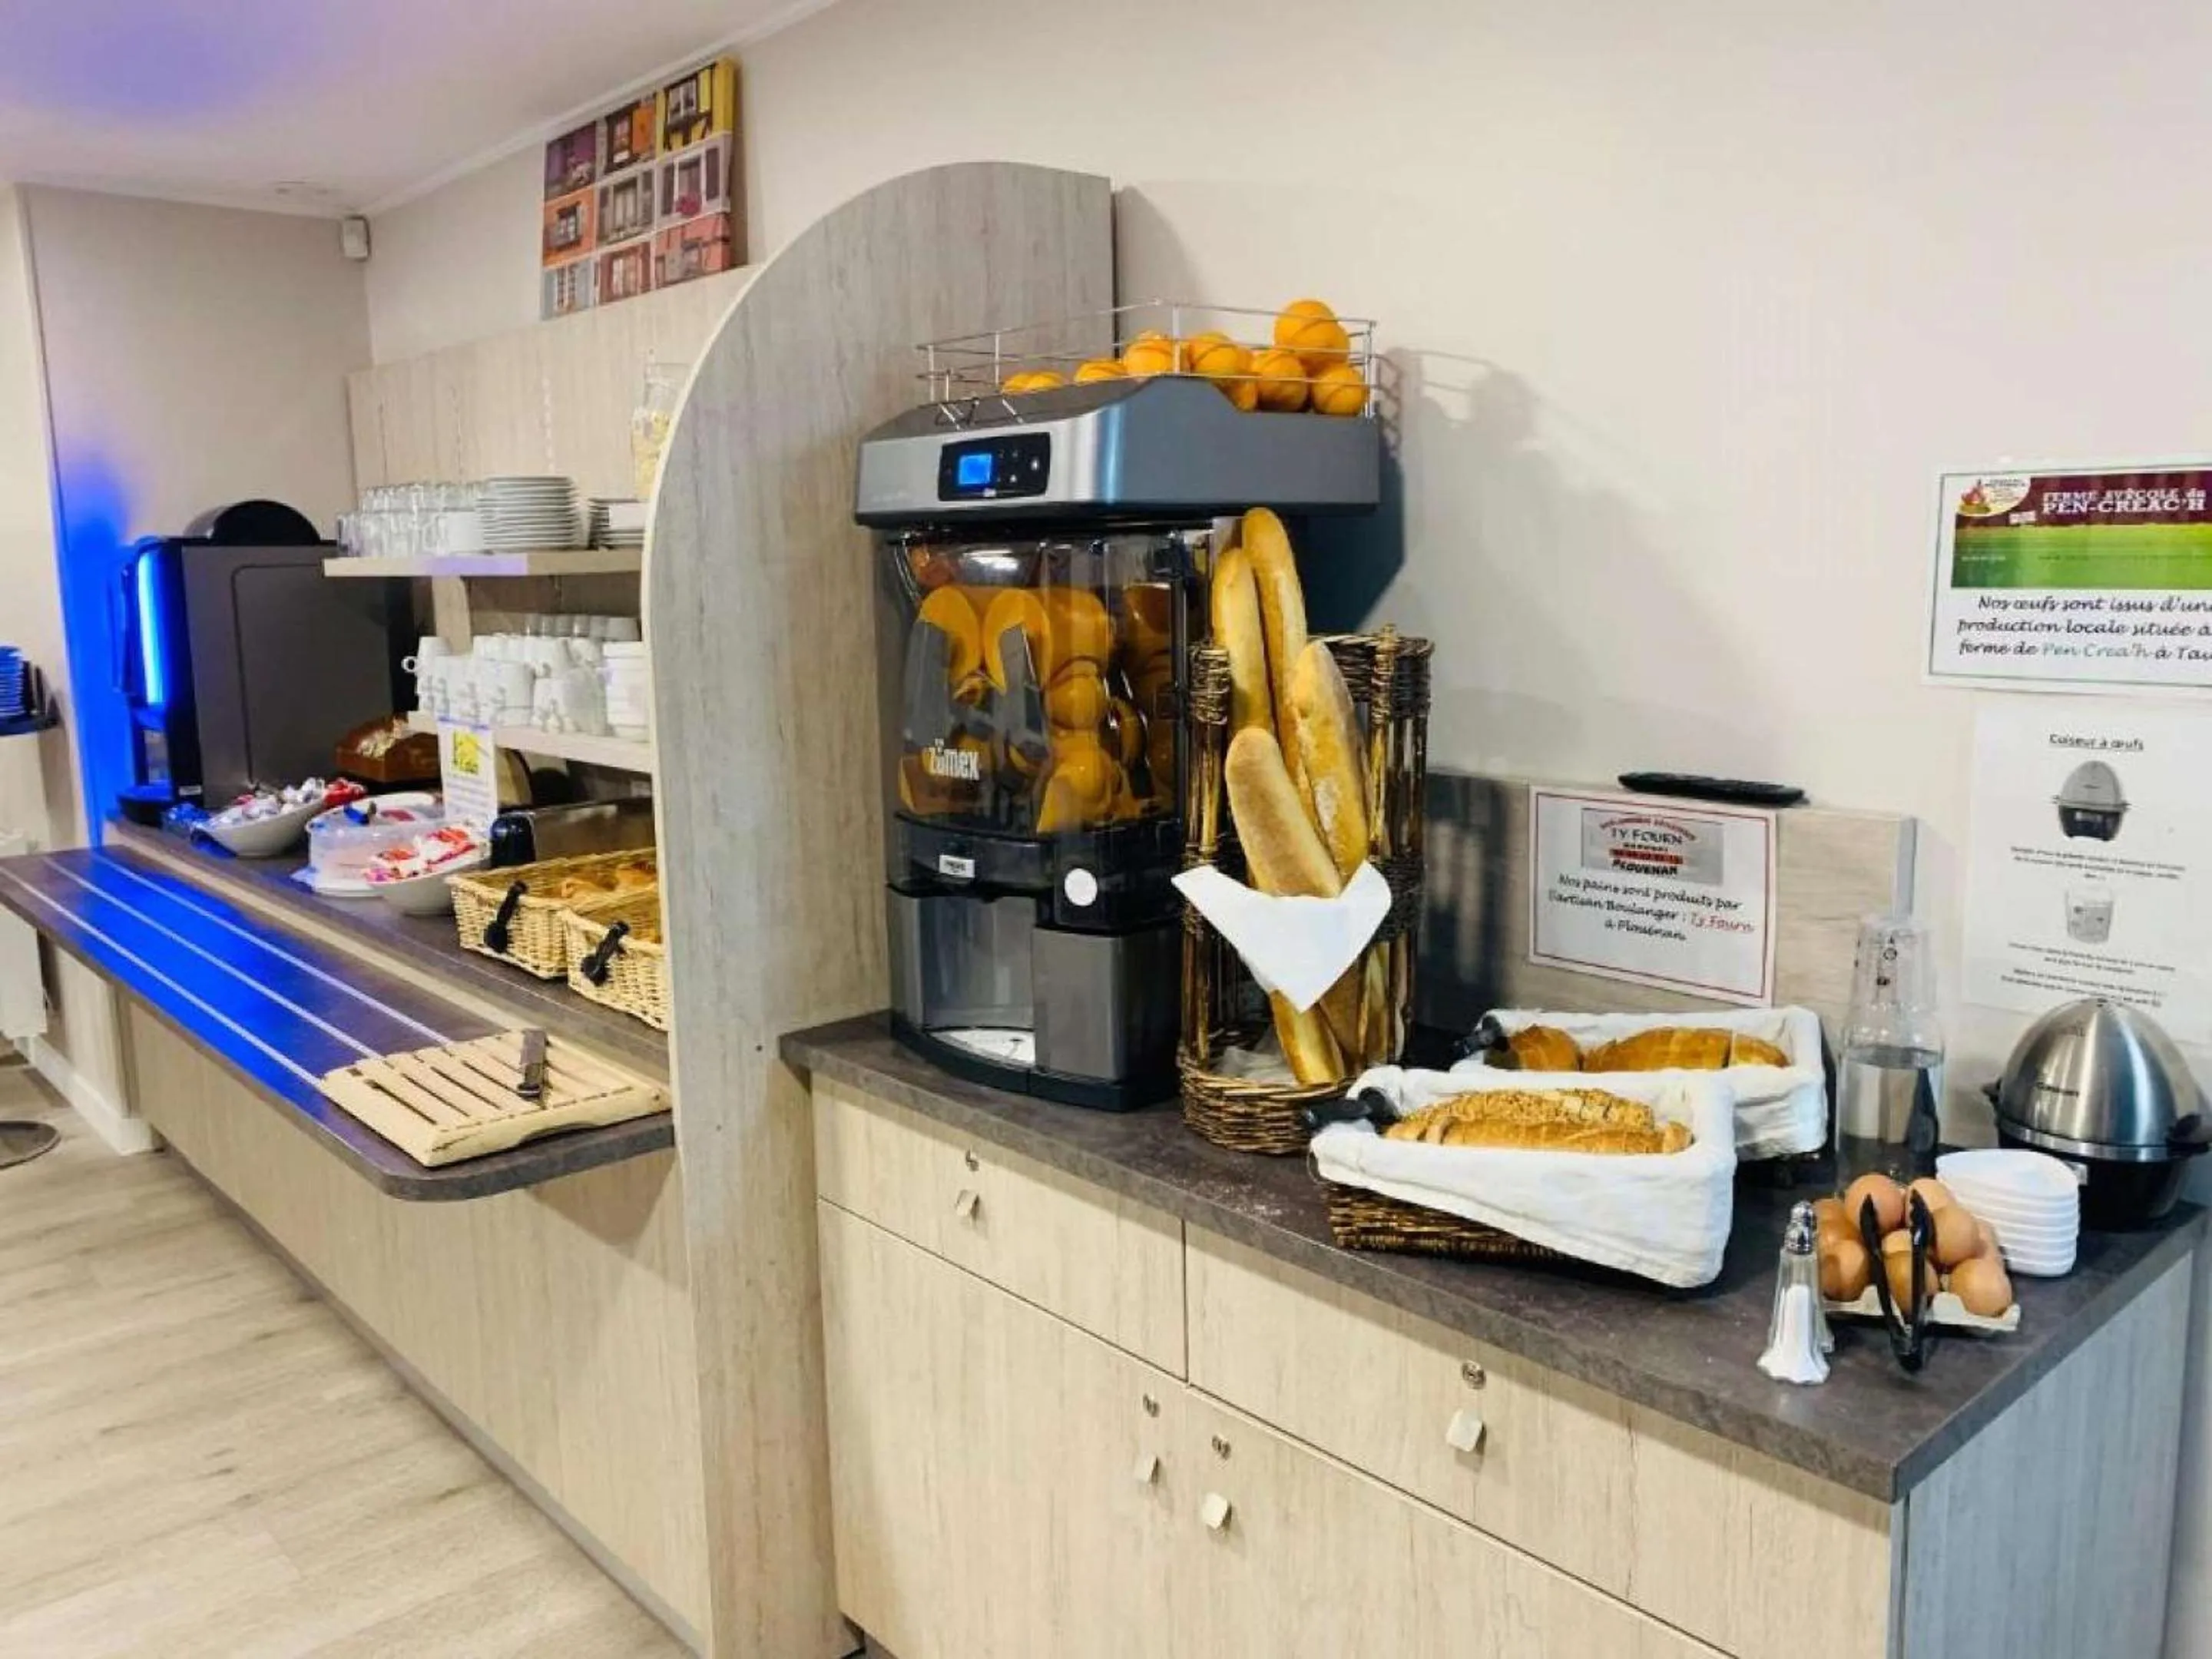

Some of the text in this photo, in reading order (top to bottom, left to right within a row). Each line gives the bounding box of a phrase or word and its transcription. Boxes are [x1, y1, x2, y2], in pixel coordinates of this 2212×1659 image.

[1979, 595, 2010, 611] Nos
[2061, 598, 2108, 612] sont
[2110, 598, 2155, 612] issus
[1958, 618, 2065, 635] production
[2066, 619, 2129, 634] locale
[1959, 639, 2012, 655] ferme
[2012, 641, 2039, 655] de
[1558, 873, 1581, 888] Nos
